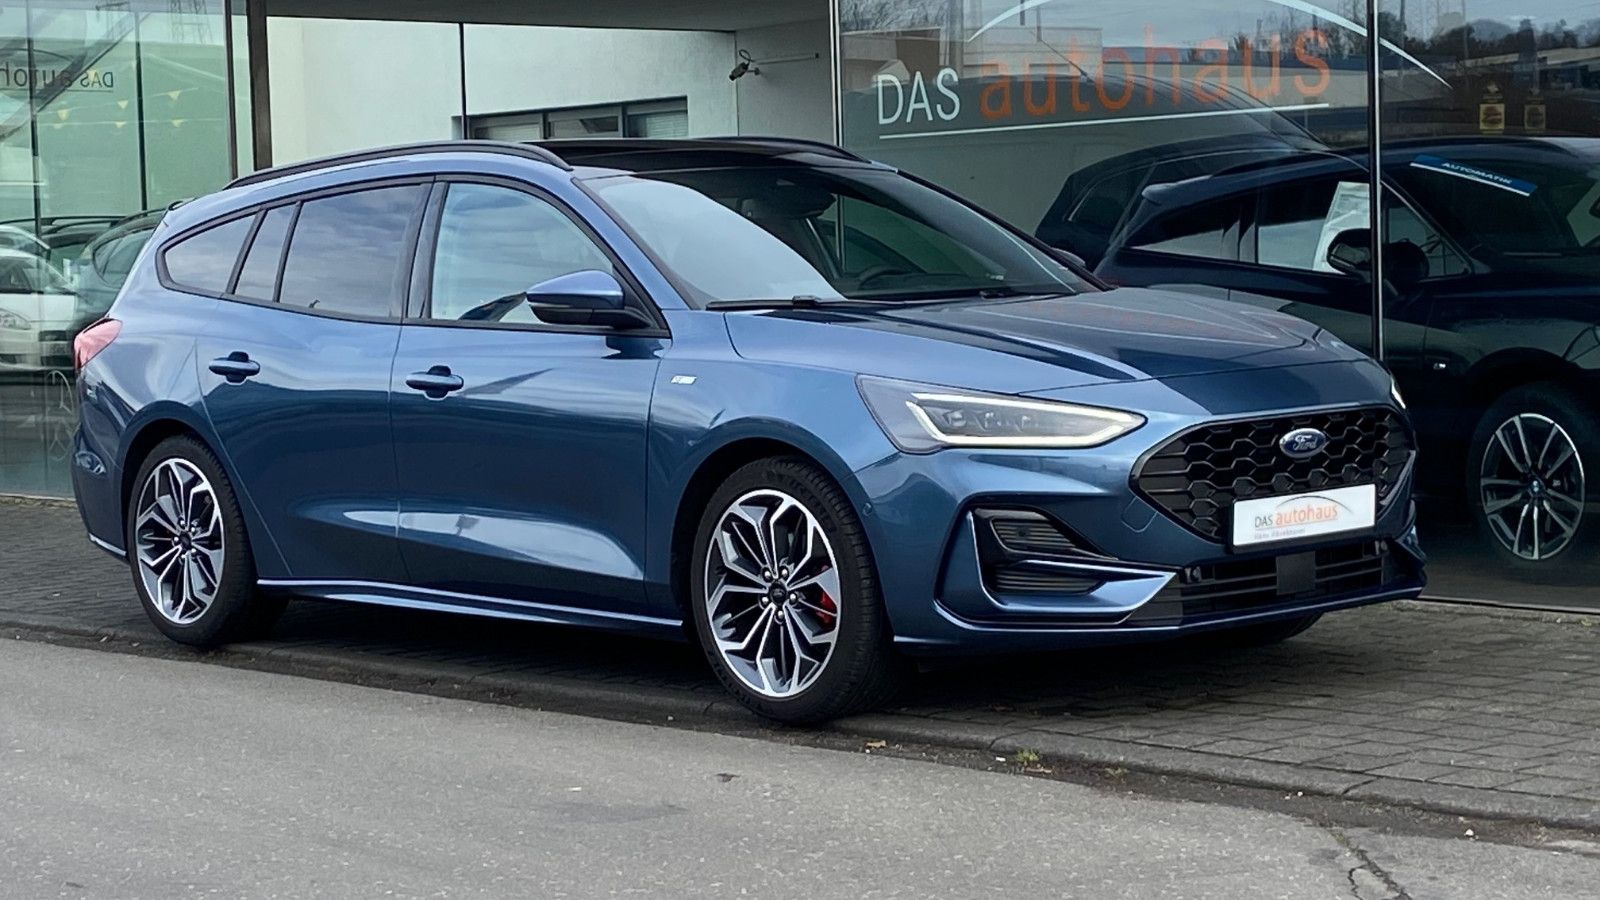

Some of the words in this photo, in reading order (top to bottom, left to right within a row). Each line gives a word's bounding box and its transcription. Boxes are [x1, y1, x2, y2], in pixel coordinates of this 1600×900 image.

[879, 68, 961, 126] DAS
[980, 24, 1331, 120] autohaus
[1441, 161, 1513, 185] AUTOMATIK
[1293, 434, 1318, 451] Ford
[1254, 515, 1274, 528] DAS
[1276, 504, 1338, 525] autohaus
